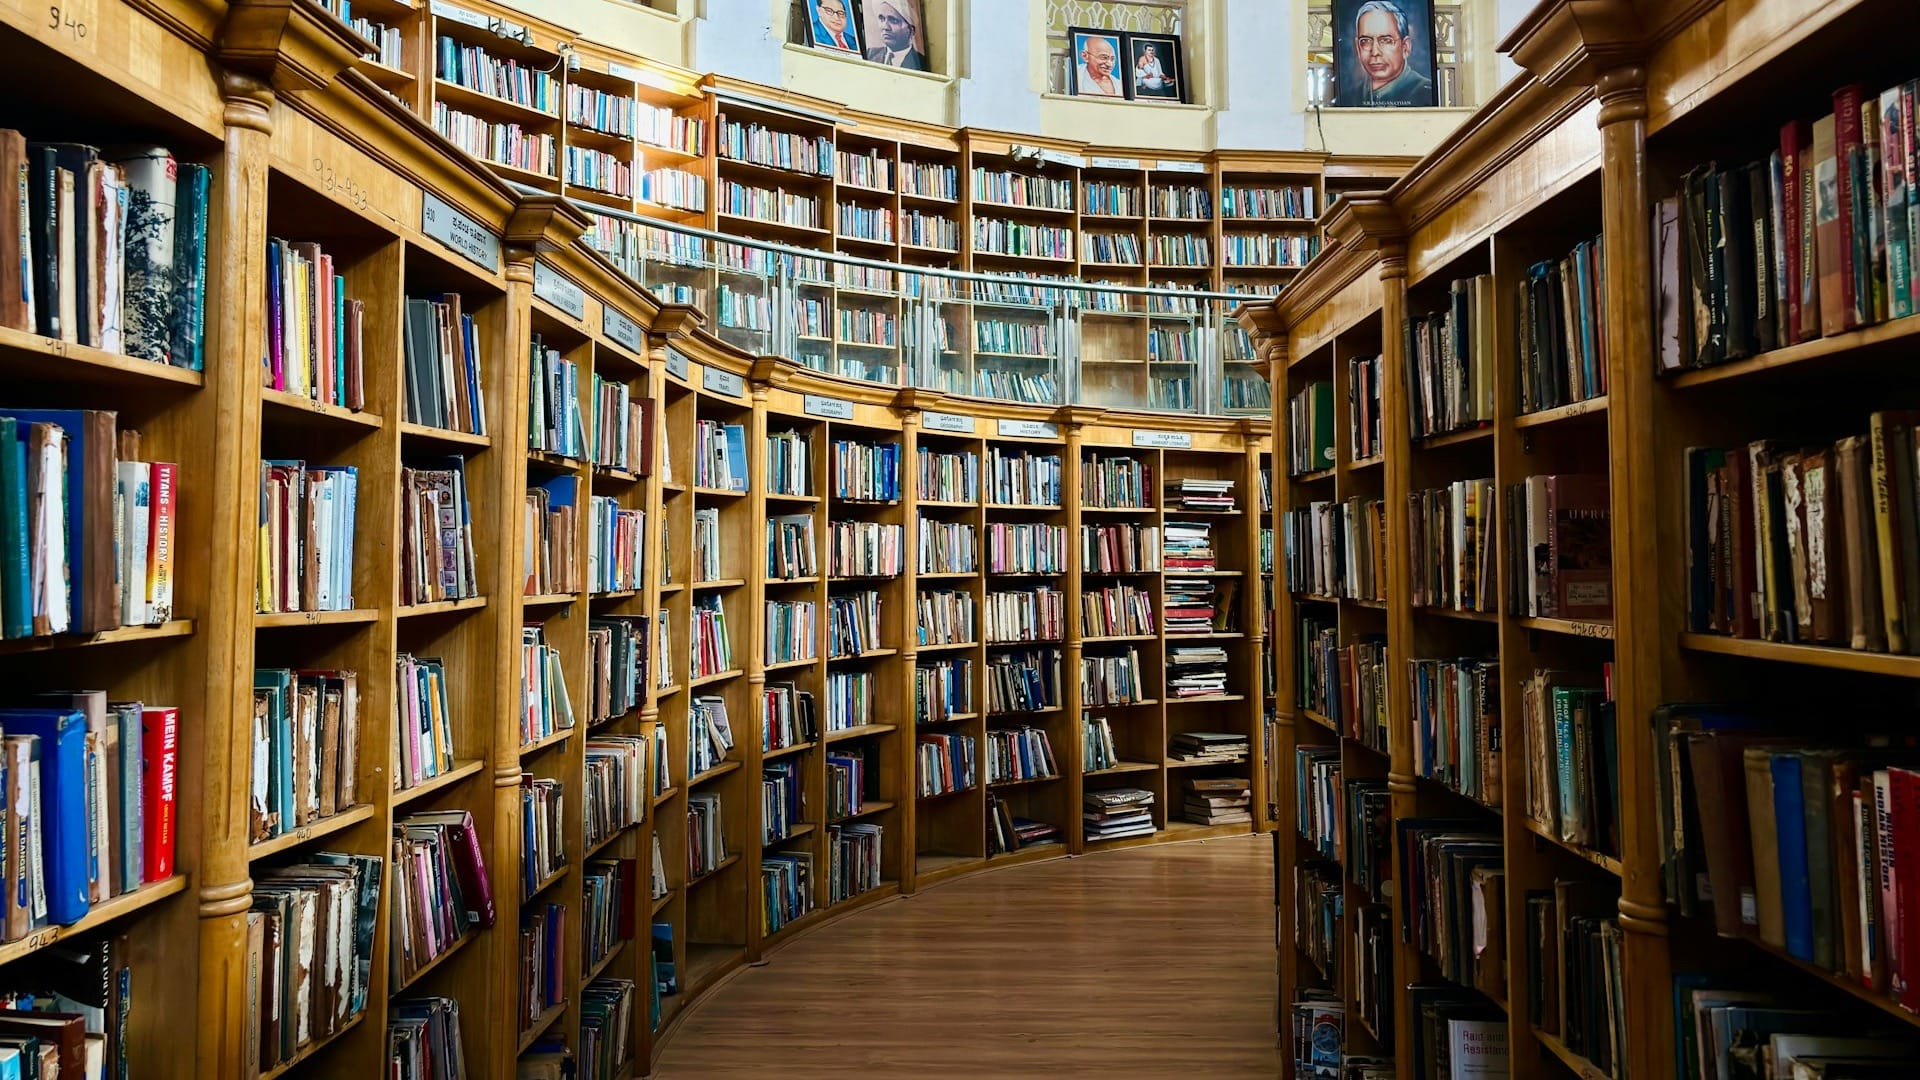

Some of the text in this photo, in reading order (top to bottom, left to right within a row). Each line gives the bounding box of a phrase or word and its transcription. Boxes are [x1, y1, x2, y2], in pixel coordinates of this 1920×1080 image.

[48, 6, 87, 41] 940
[313, 158, 368, 211] 931-933
[450, 231, 488, 261] WORLD HISTORY
[160, 467, 170, 505] TITANS
[158, 515, 169, 562] HISTORY
[162, 712, 175, 802] MEIN KAMPF
[1563, 742, 1569, 752] OF
[20, 824, 27, 835] IN
[1876, 786, 1890, 891] INDIAN HISTORY
[29, 928, 58, 949] 943
[1463, 1030, 1505, 1042] Raid and
[1463, 1043, 1510, 1055] Resistanc
